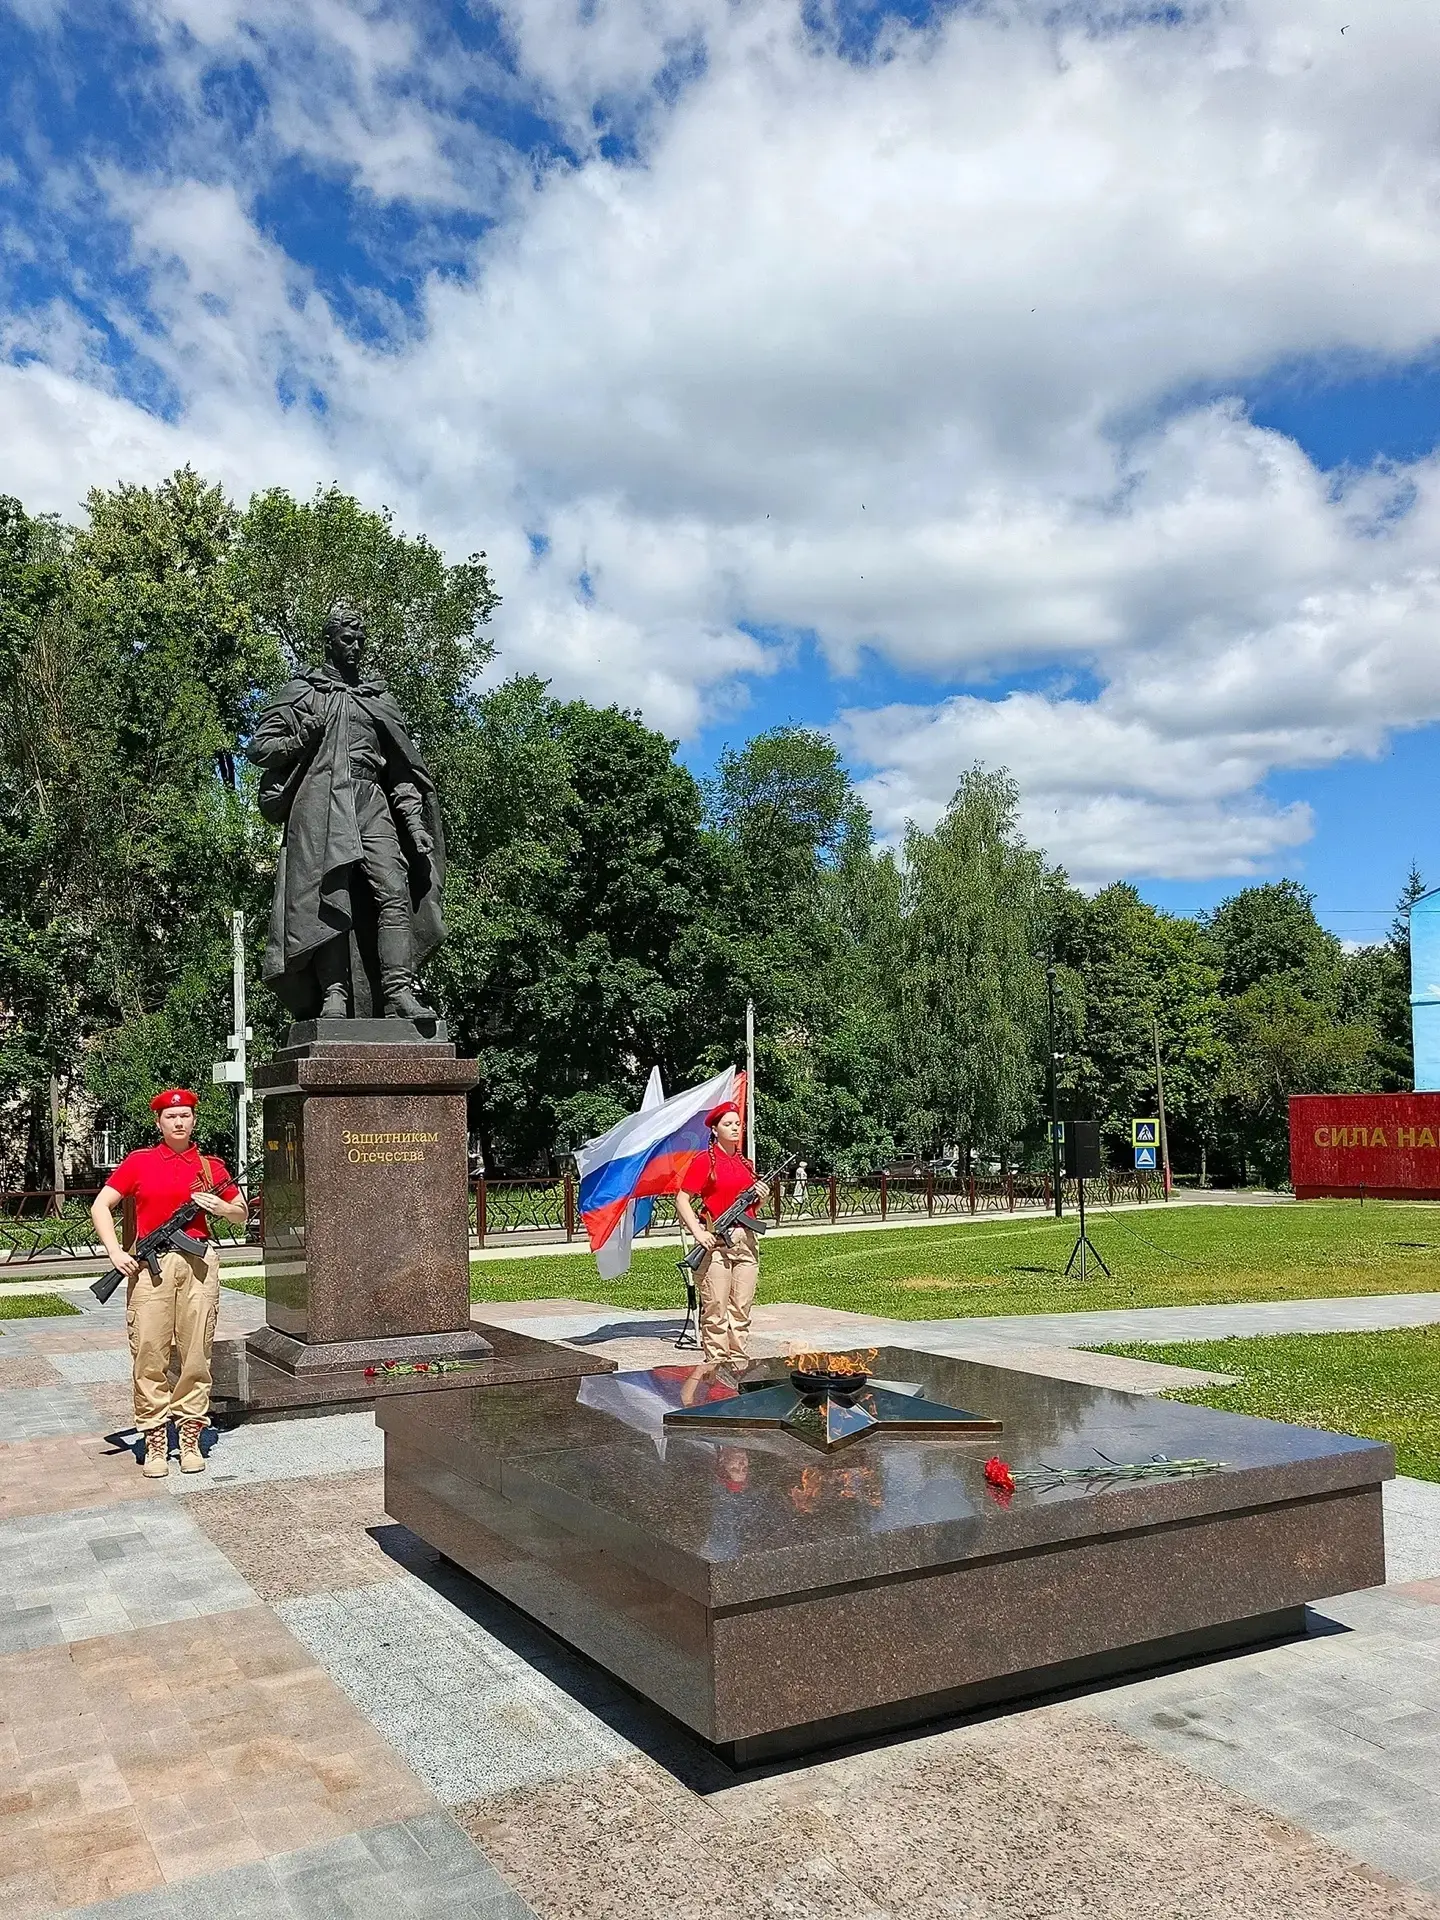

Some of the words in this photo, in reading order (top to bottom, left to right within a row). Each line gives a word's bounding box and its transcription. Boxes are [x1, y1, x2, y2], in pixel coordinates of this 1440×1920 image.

[341, 1130, 439, 1145] Защитникам
[1314, 1127, 1388, 1147] СИЛА
[1397, 1127, 1440, 1147] НА
[348, 1148, 426, 1163] Отечества
